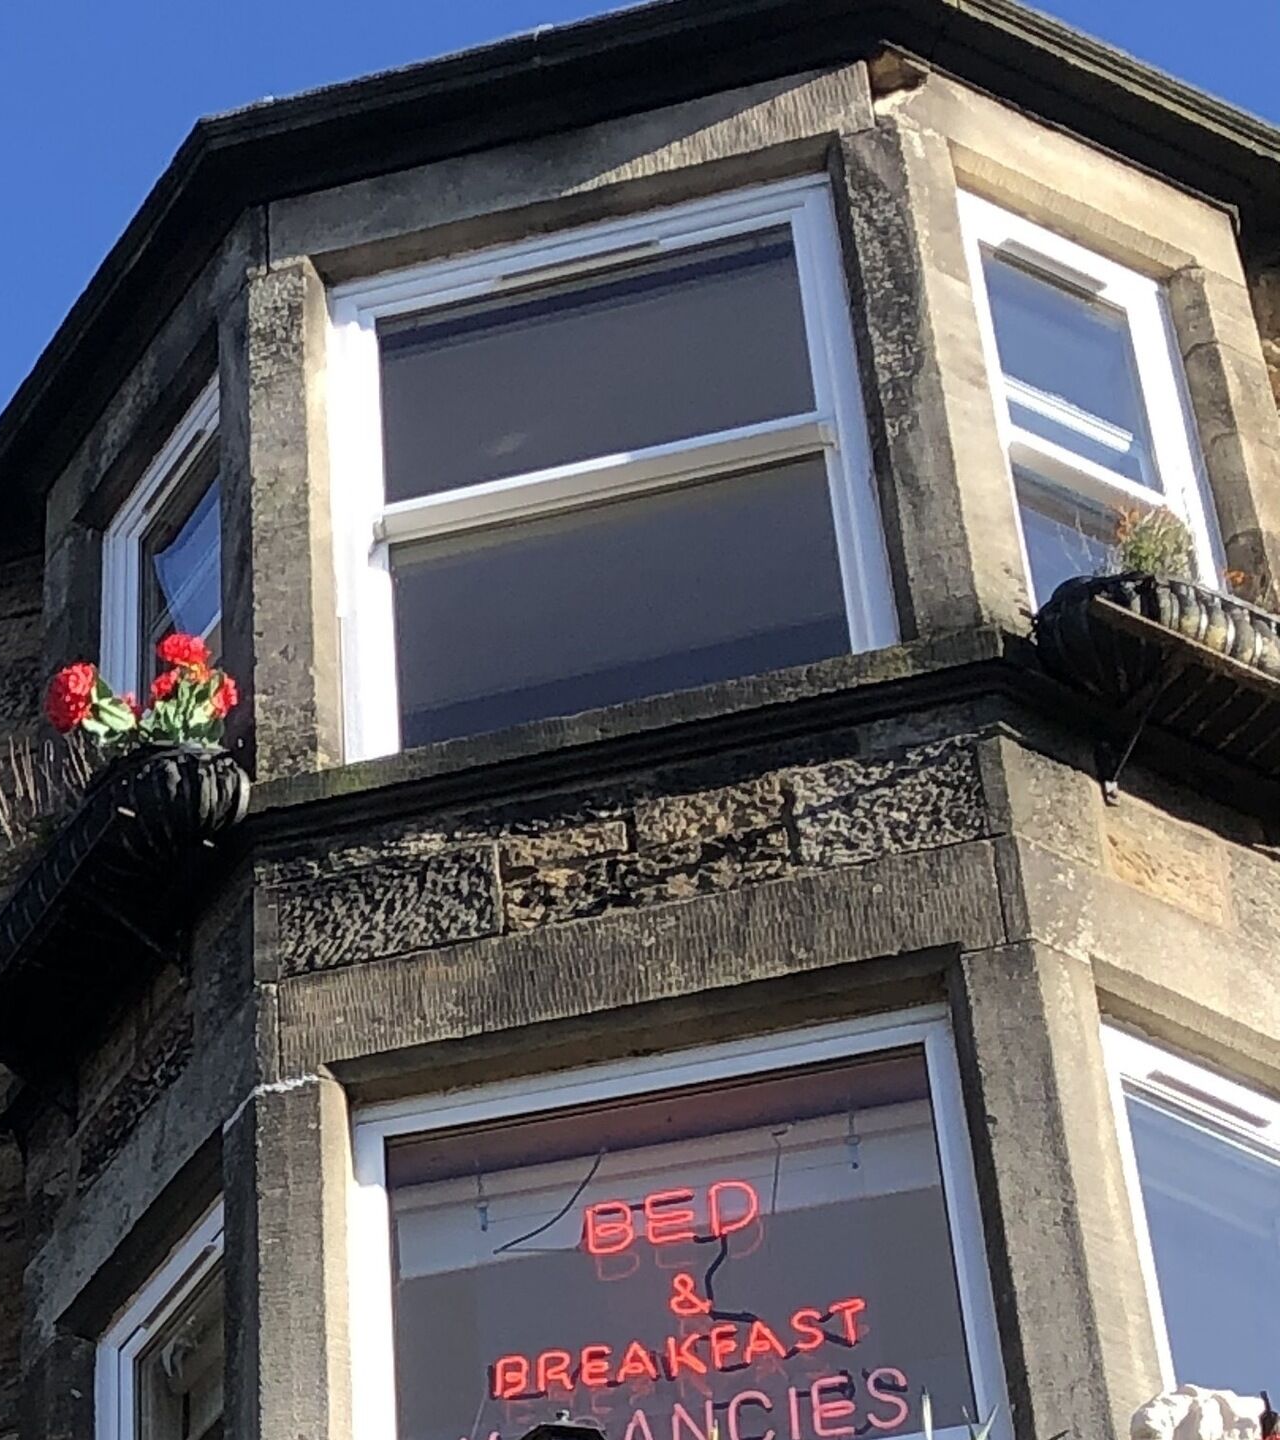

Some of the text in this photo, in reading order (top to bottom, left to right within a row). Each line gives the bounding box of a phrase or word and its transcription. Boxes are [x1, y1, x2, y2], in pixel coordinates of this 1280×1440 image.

[583, 1180, 759, 1255] BED
[669, 1272, 711, 1315] &
[493, 1298, 866, 1398] BREAKFAST
